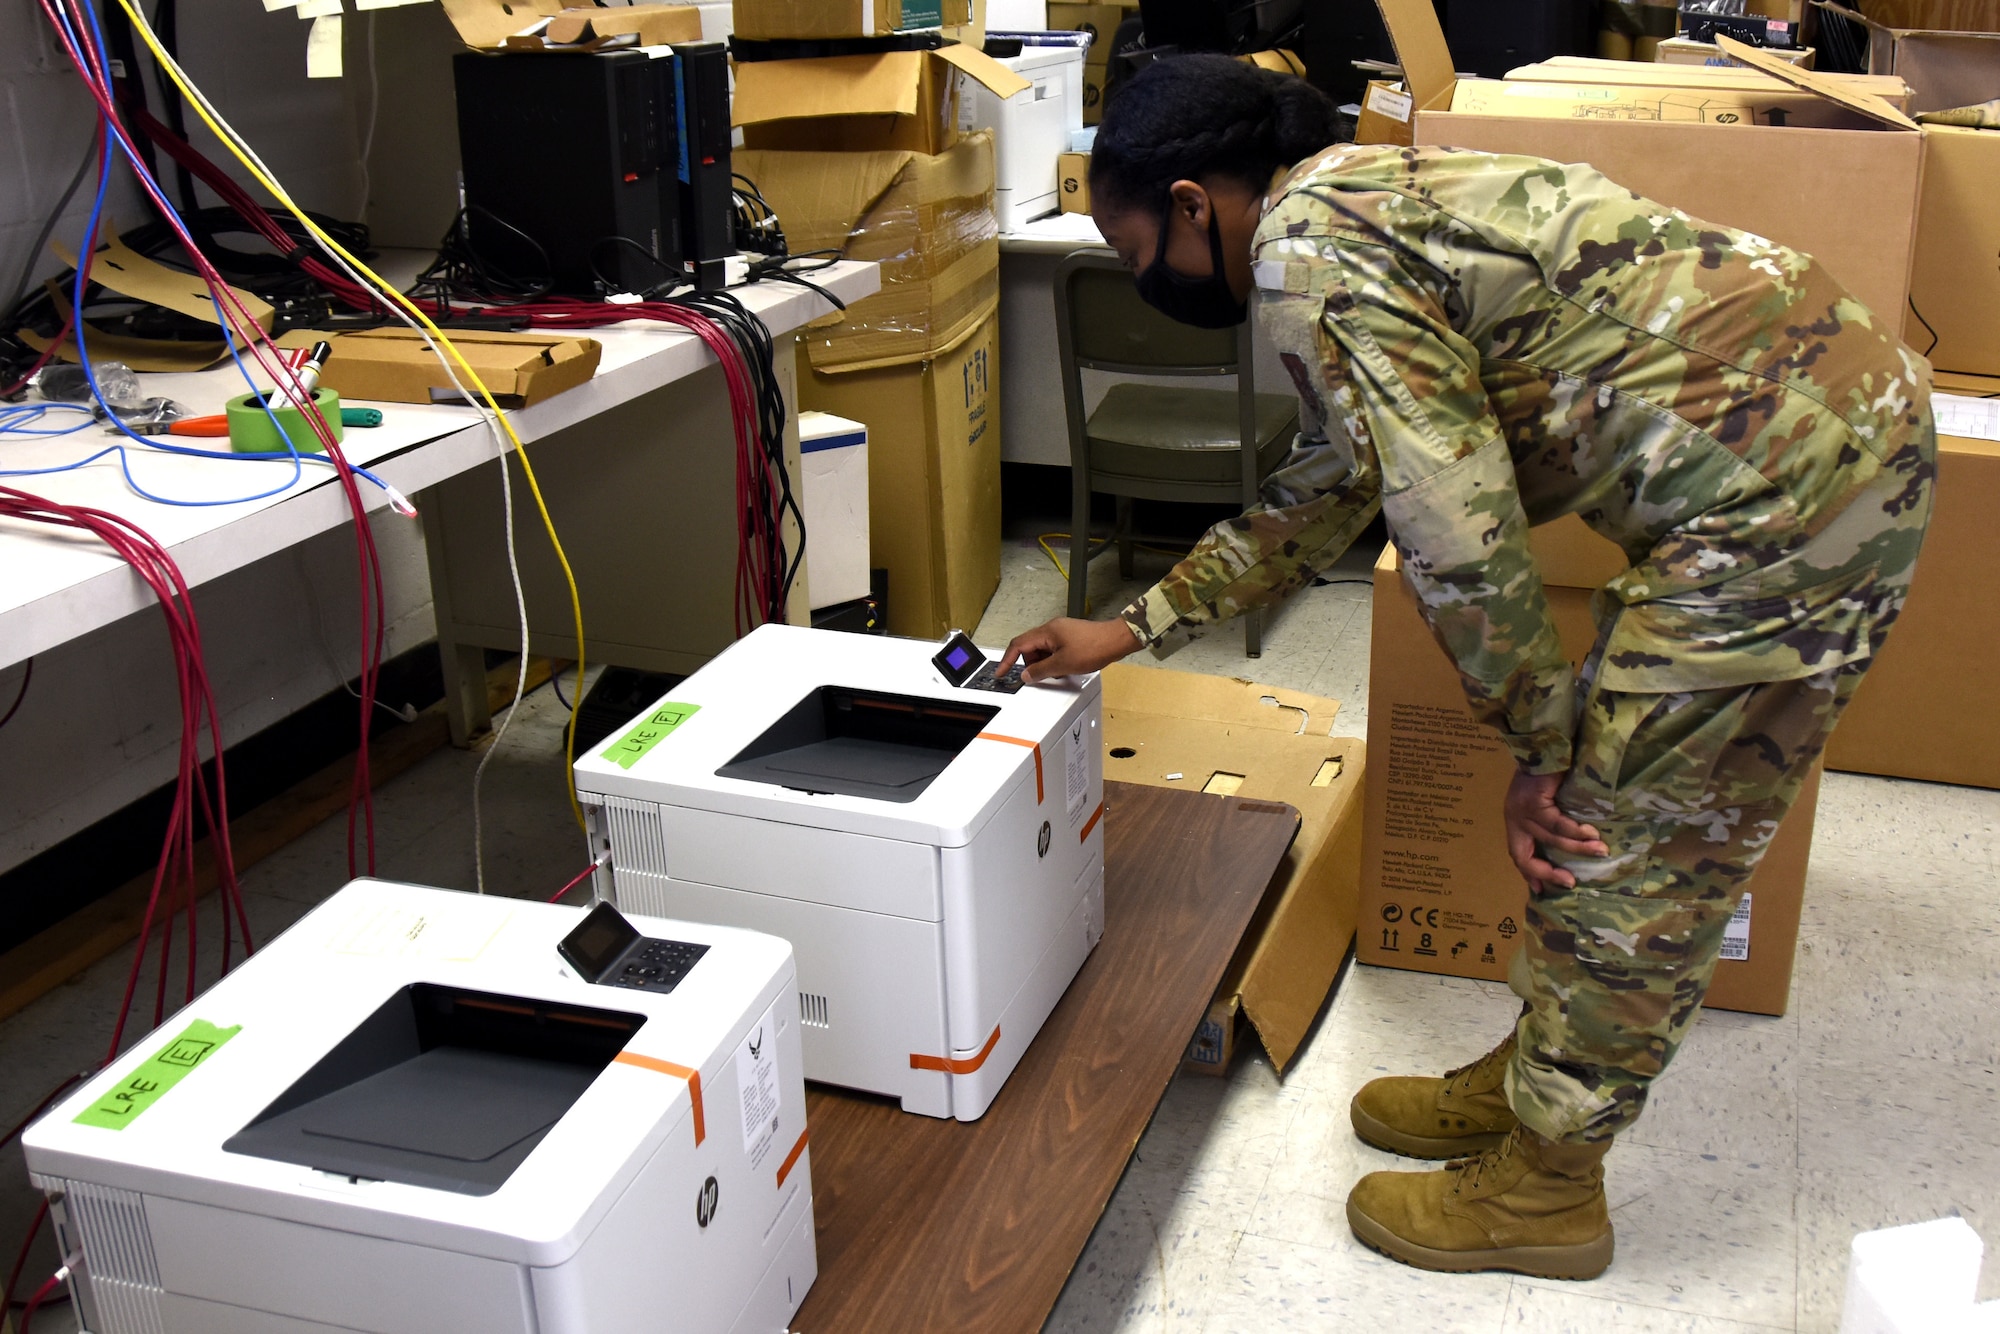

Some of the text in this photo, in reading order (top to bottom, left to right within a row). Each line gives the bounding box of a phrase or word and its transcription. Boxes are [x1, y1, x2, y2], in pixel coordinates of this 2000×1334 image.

[1715, 113, 1739, 124] hp
[1392, 709, 1437, 719] Hewlett-Packard
[1439, 714, 1468, 723] Argentina
[621, 731, 658, 752] LRE
[1390, 742, 1435, 752] Hewlett-Packard
[1387, 796, 1431, 806] Hewlett-Packard
[1383, 848, 1439, 863] www.hp.com
[1383, 859, 1450, 873] Hewlett-Packard Company
[1381, 882, 1415, 892] Development
[1402, 878, 1443, 887] Hewlett-Packard
[1420, 933, 1432, 948] 8
[100, 1078, 158, 1115] LRE
[697, 1176, 718, 1227] hp
